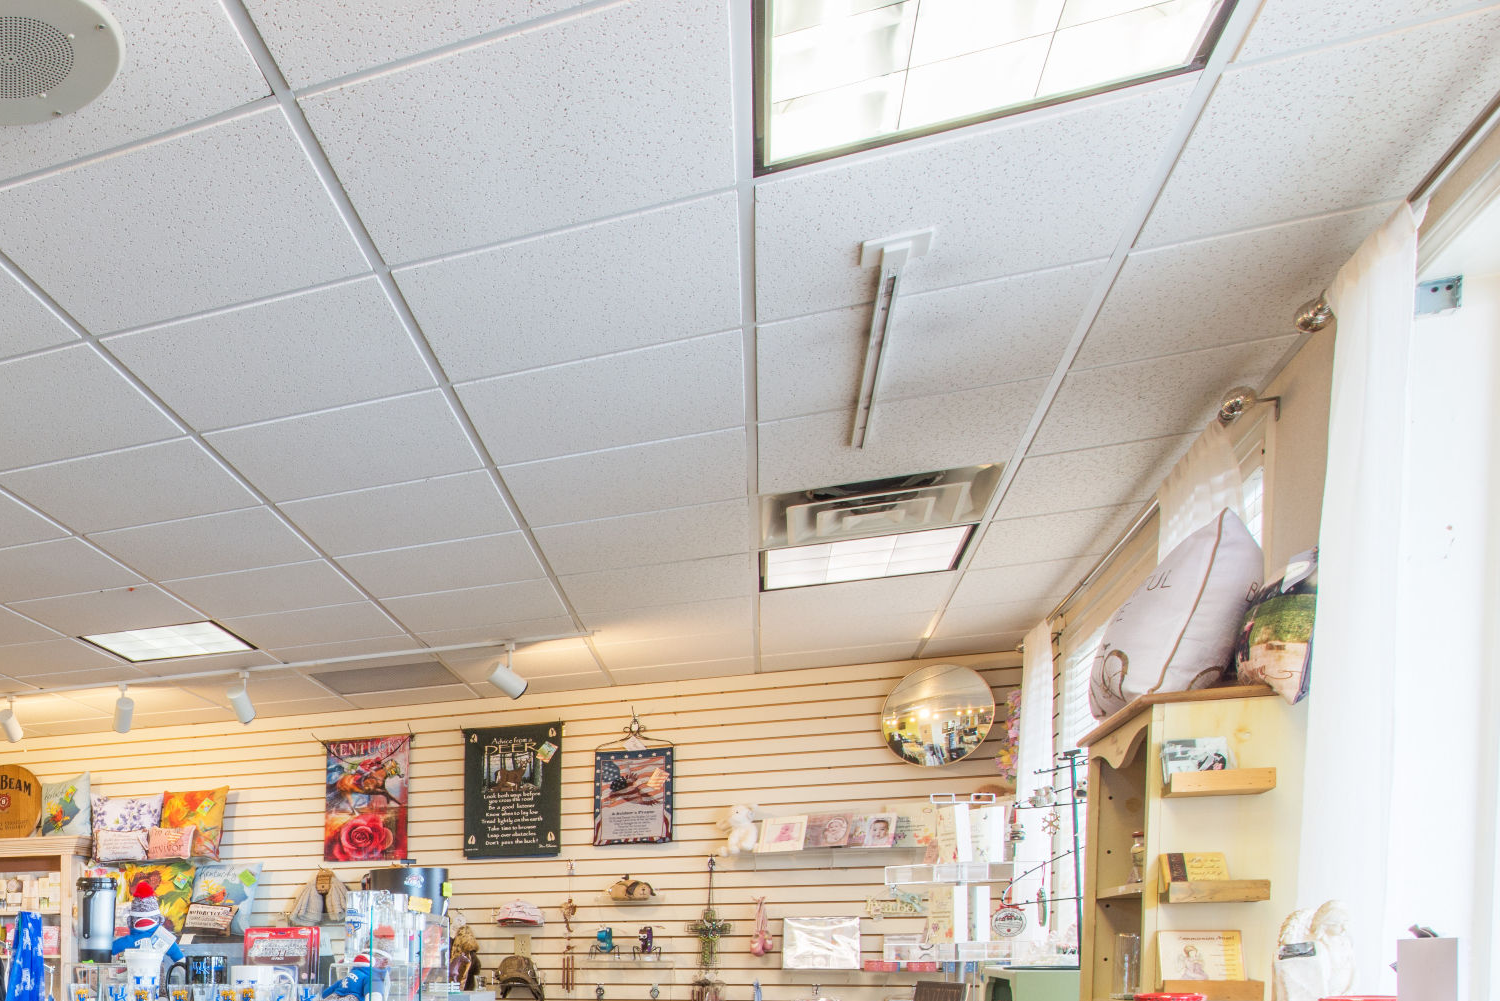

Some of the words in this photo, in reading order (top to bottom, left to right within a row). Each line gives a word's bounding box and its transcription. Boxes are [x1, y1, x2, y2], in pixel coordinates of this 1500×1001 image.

[491, 737, 513, 745] Advice
[513, 736, 527, 745] from
[330, 739, 405, 758] KENTUCKY
[483, 742, 539, 756] DEER
[0, 773, 33, 797] BEAM
[522, 790, 541, 798] before
[501, 803, 514, 811] good
[497, 817, 513, 825] lightly
[487, 832, 500, 840] Leap
[501, 839, 514, 847] pass
[1216, 932, 1237, 942] Angel
